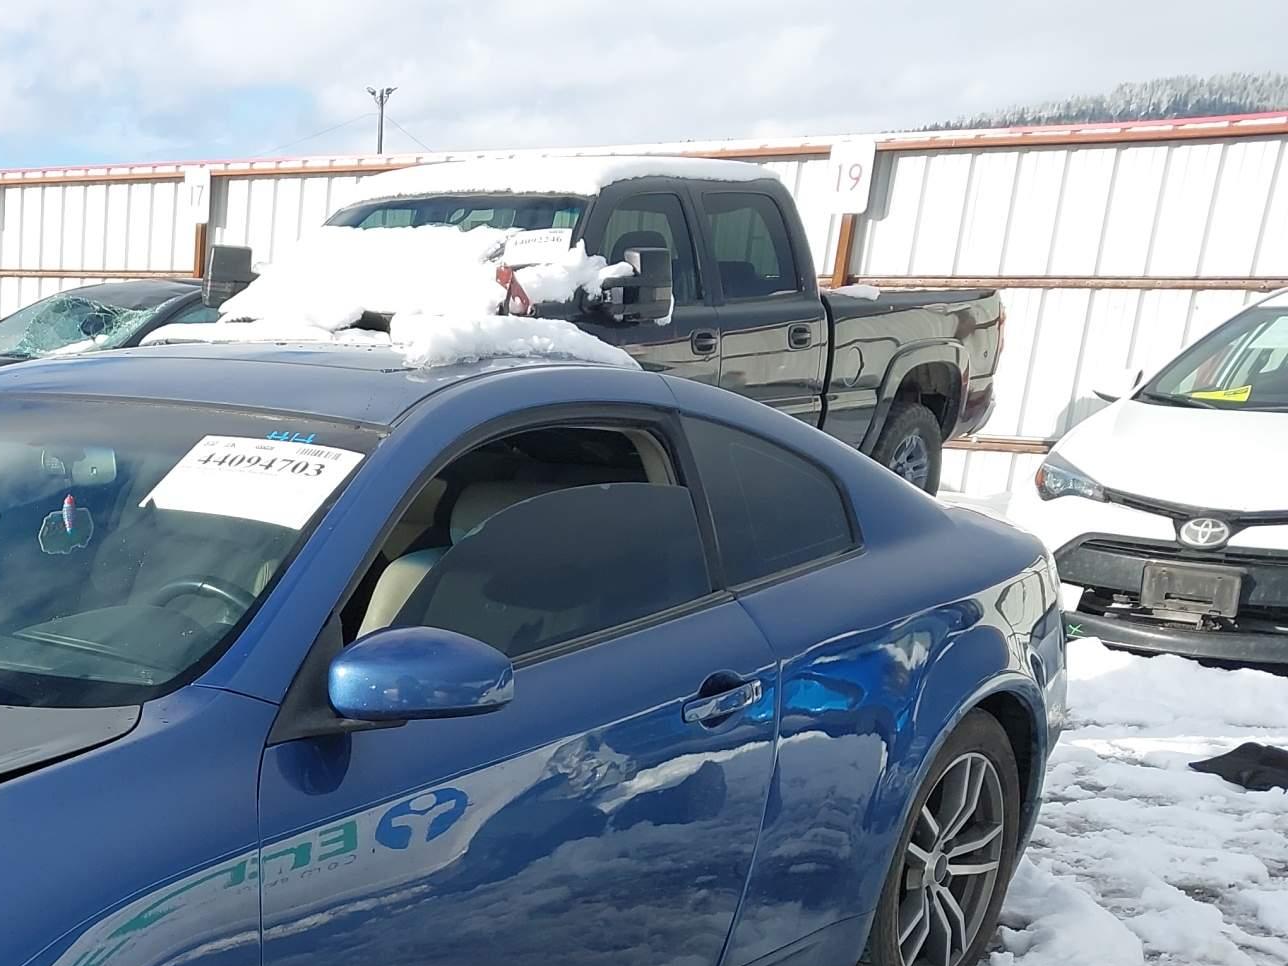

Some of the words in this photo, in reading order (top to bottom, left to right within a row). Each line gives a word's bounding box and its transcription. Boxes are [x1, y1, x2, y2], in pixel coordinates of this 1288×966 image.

[836, 163, 863, 192] 19
[190, 184, 204, 207] 17
[196, 452, 326, 478] 44094703
